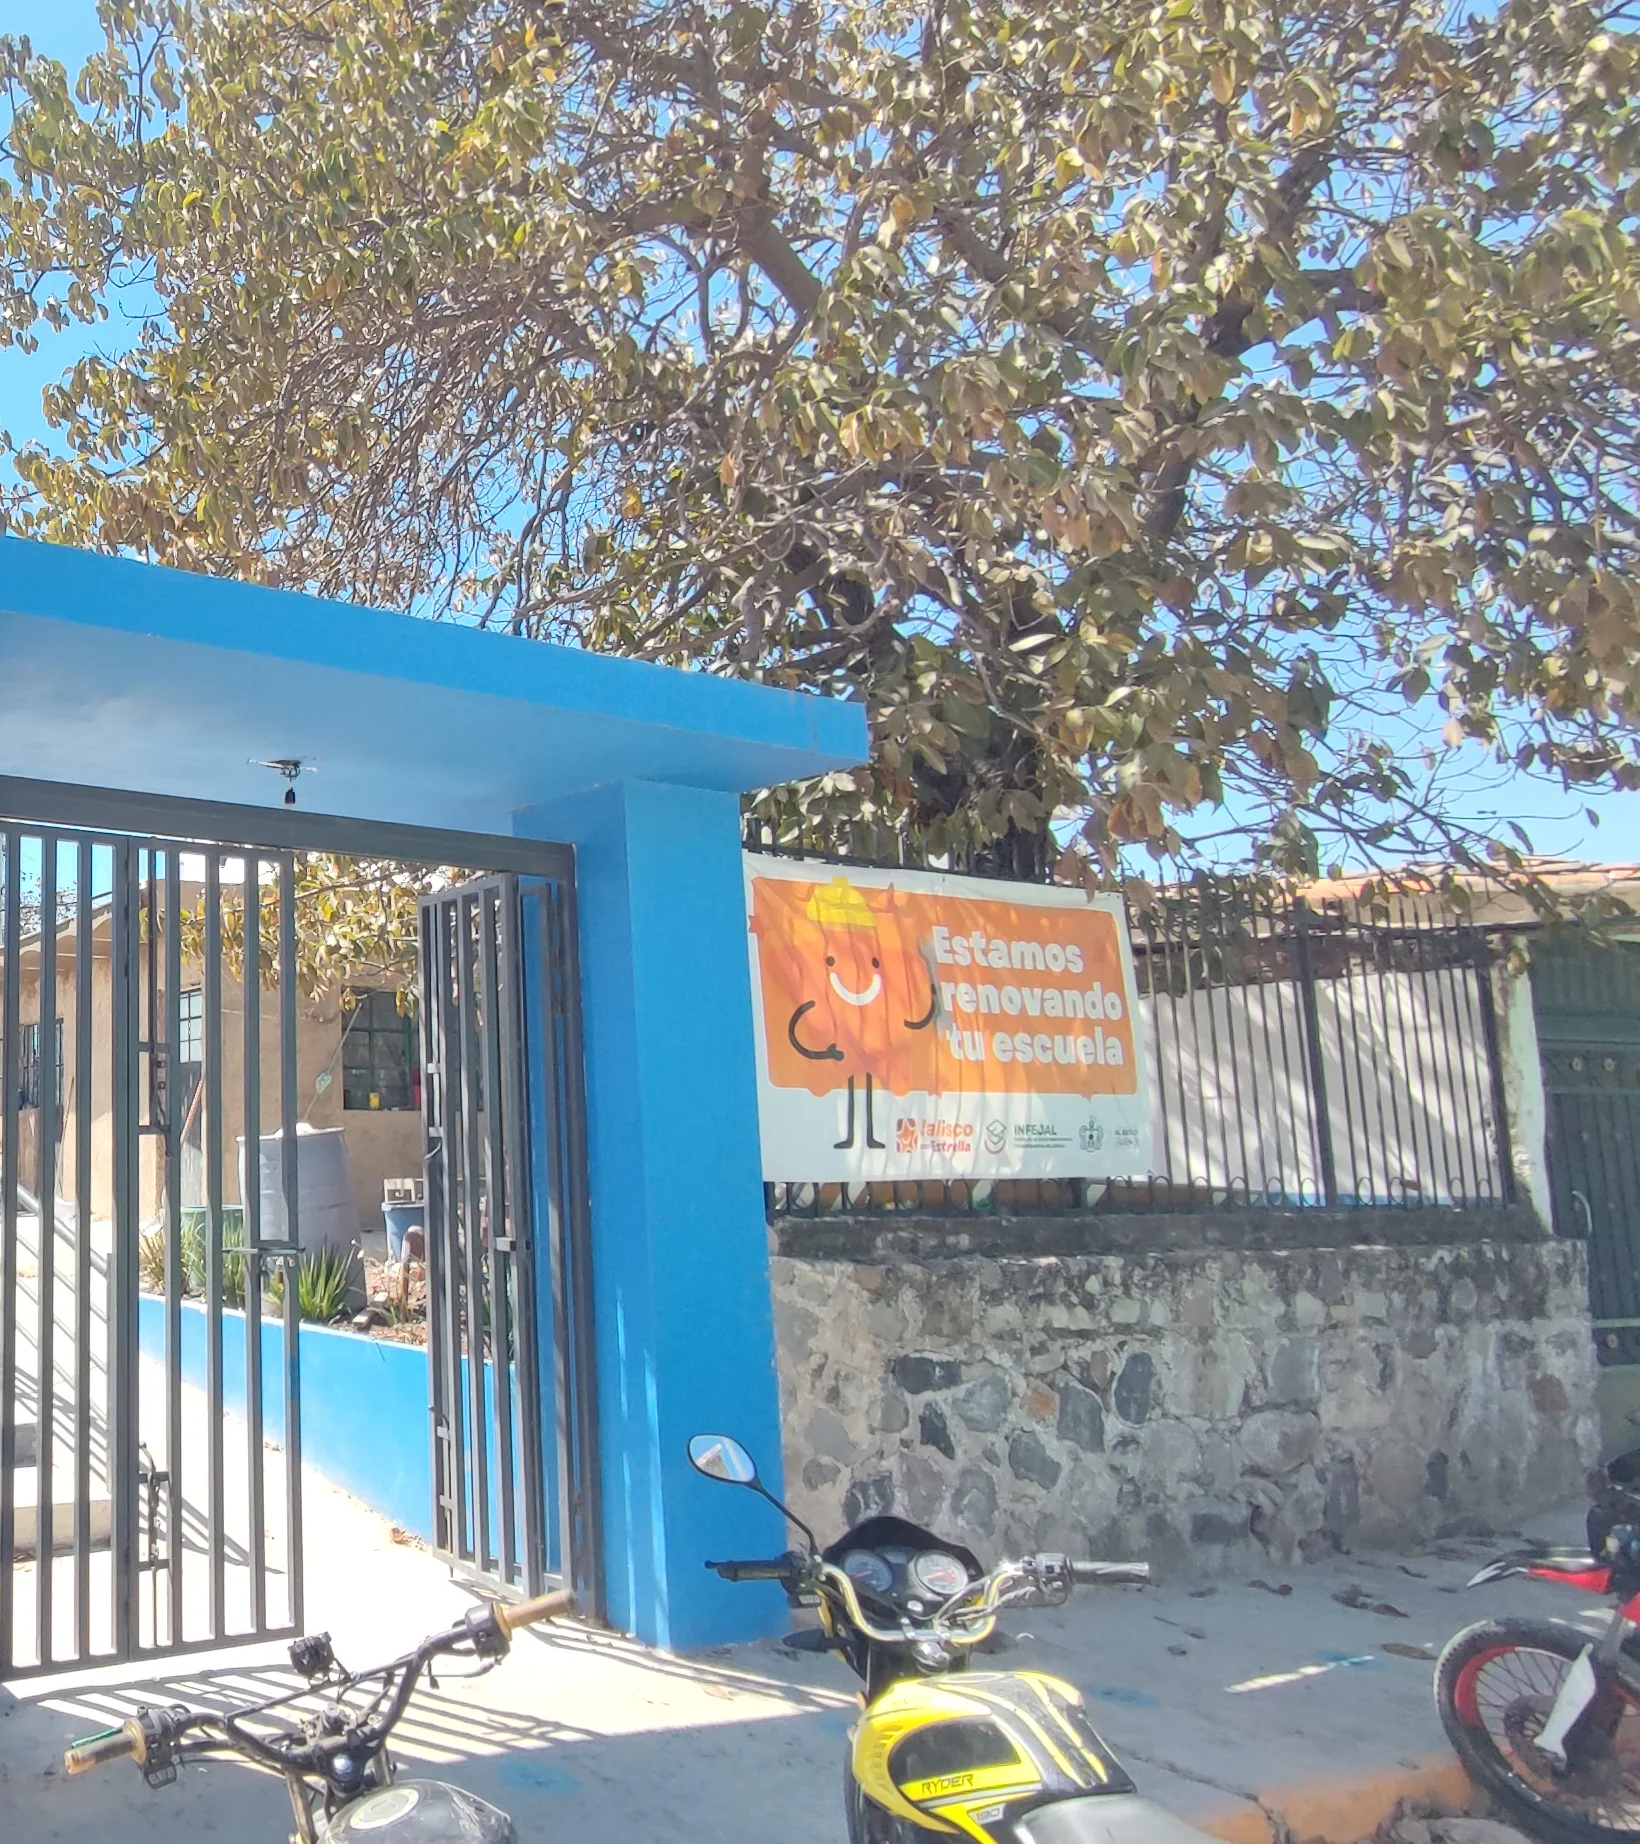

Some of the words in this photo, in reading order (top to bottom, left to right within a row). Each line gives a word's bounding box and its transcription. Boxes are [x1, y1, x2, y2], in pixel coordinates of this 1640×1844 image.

[932, 925, 1084, 974] Estamos
[940, 980, 1123, 1021] renovando
[945, 1022, 987, 1061] tu
[991, 1026, 1124, 1066] escuela
[921, 1118, 974, 1137] Jalisco
[1013, 1123, 1058, 1136] INFEJAL
[921, 1773, 974, 1795] RYDER
